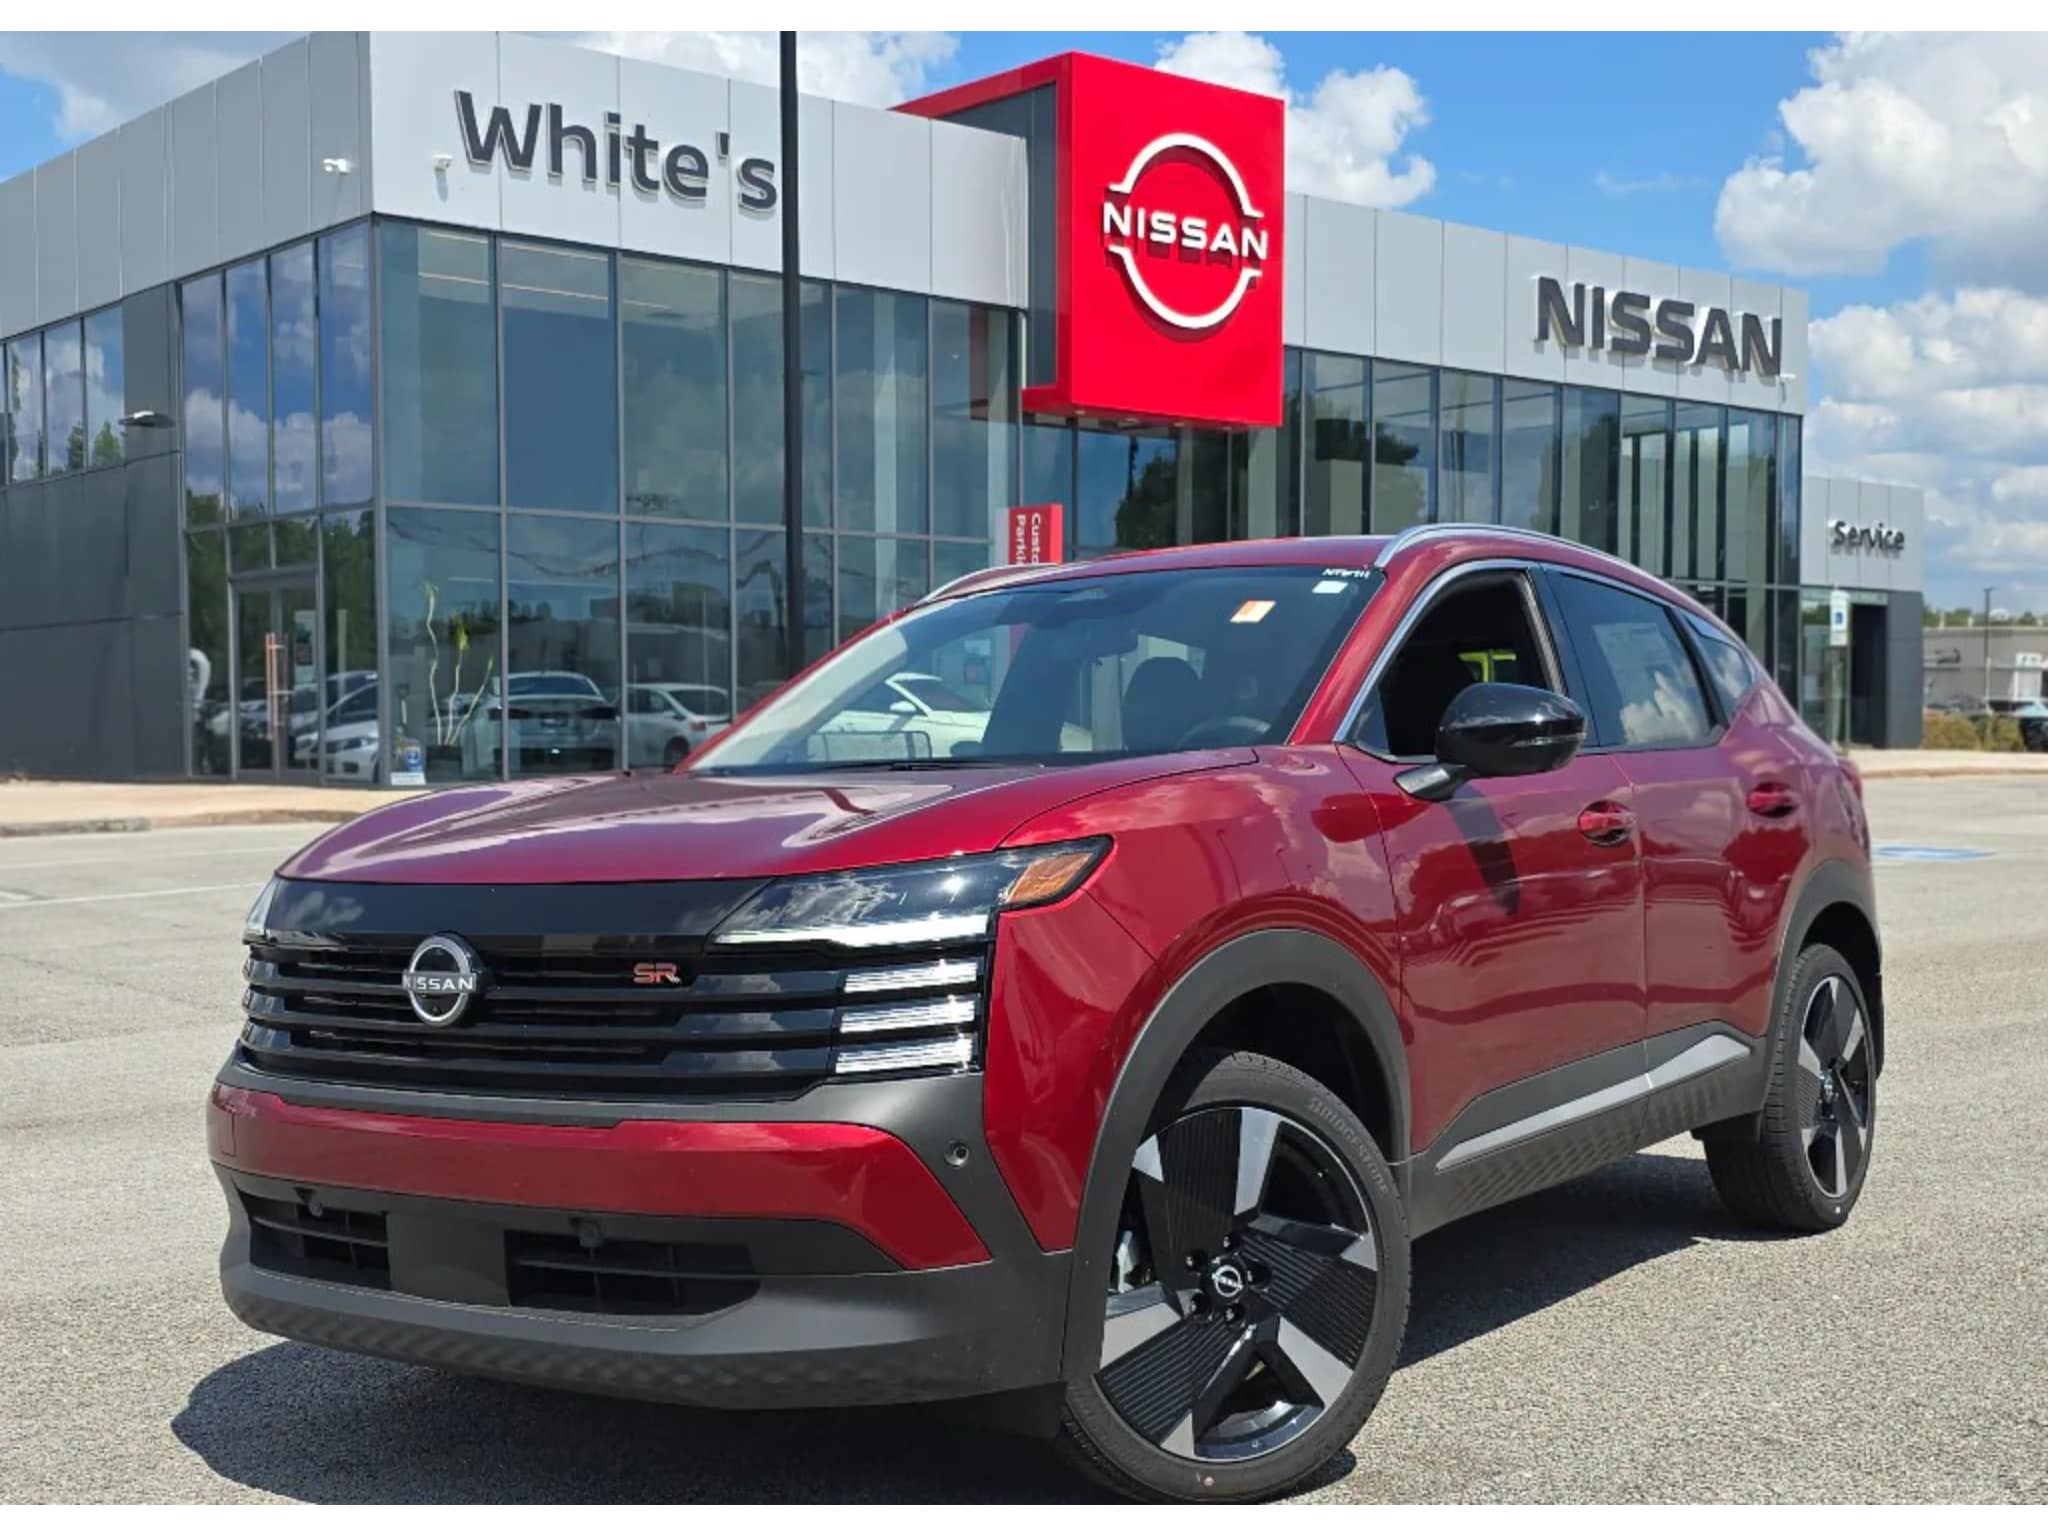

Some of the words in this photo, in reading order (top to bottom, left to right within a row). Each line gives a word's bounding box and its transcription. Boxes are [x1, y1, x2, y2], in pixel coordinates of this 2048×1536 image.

[455, 89, 778, 210] White's
[1103, 201, 1269, 261] NISSAN
[1537, 275, 1783, 376] NISSAN
[1832, 520, 1905, 551] Service
[402, 974, 474, 991] NISSAN
[633, 962, 678, 984] SR
